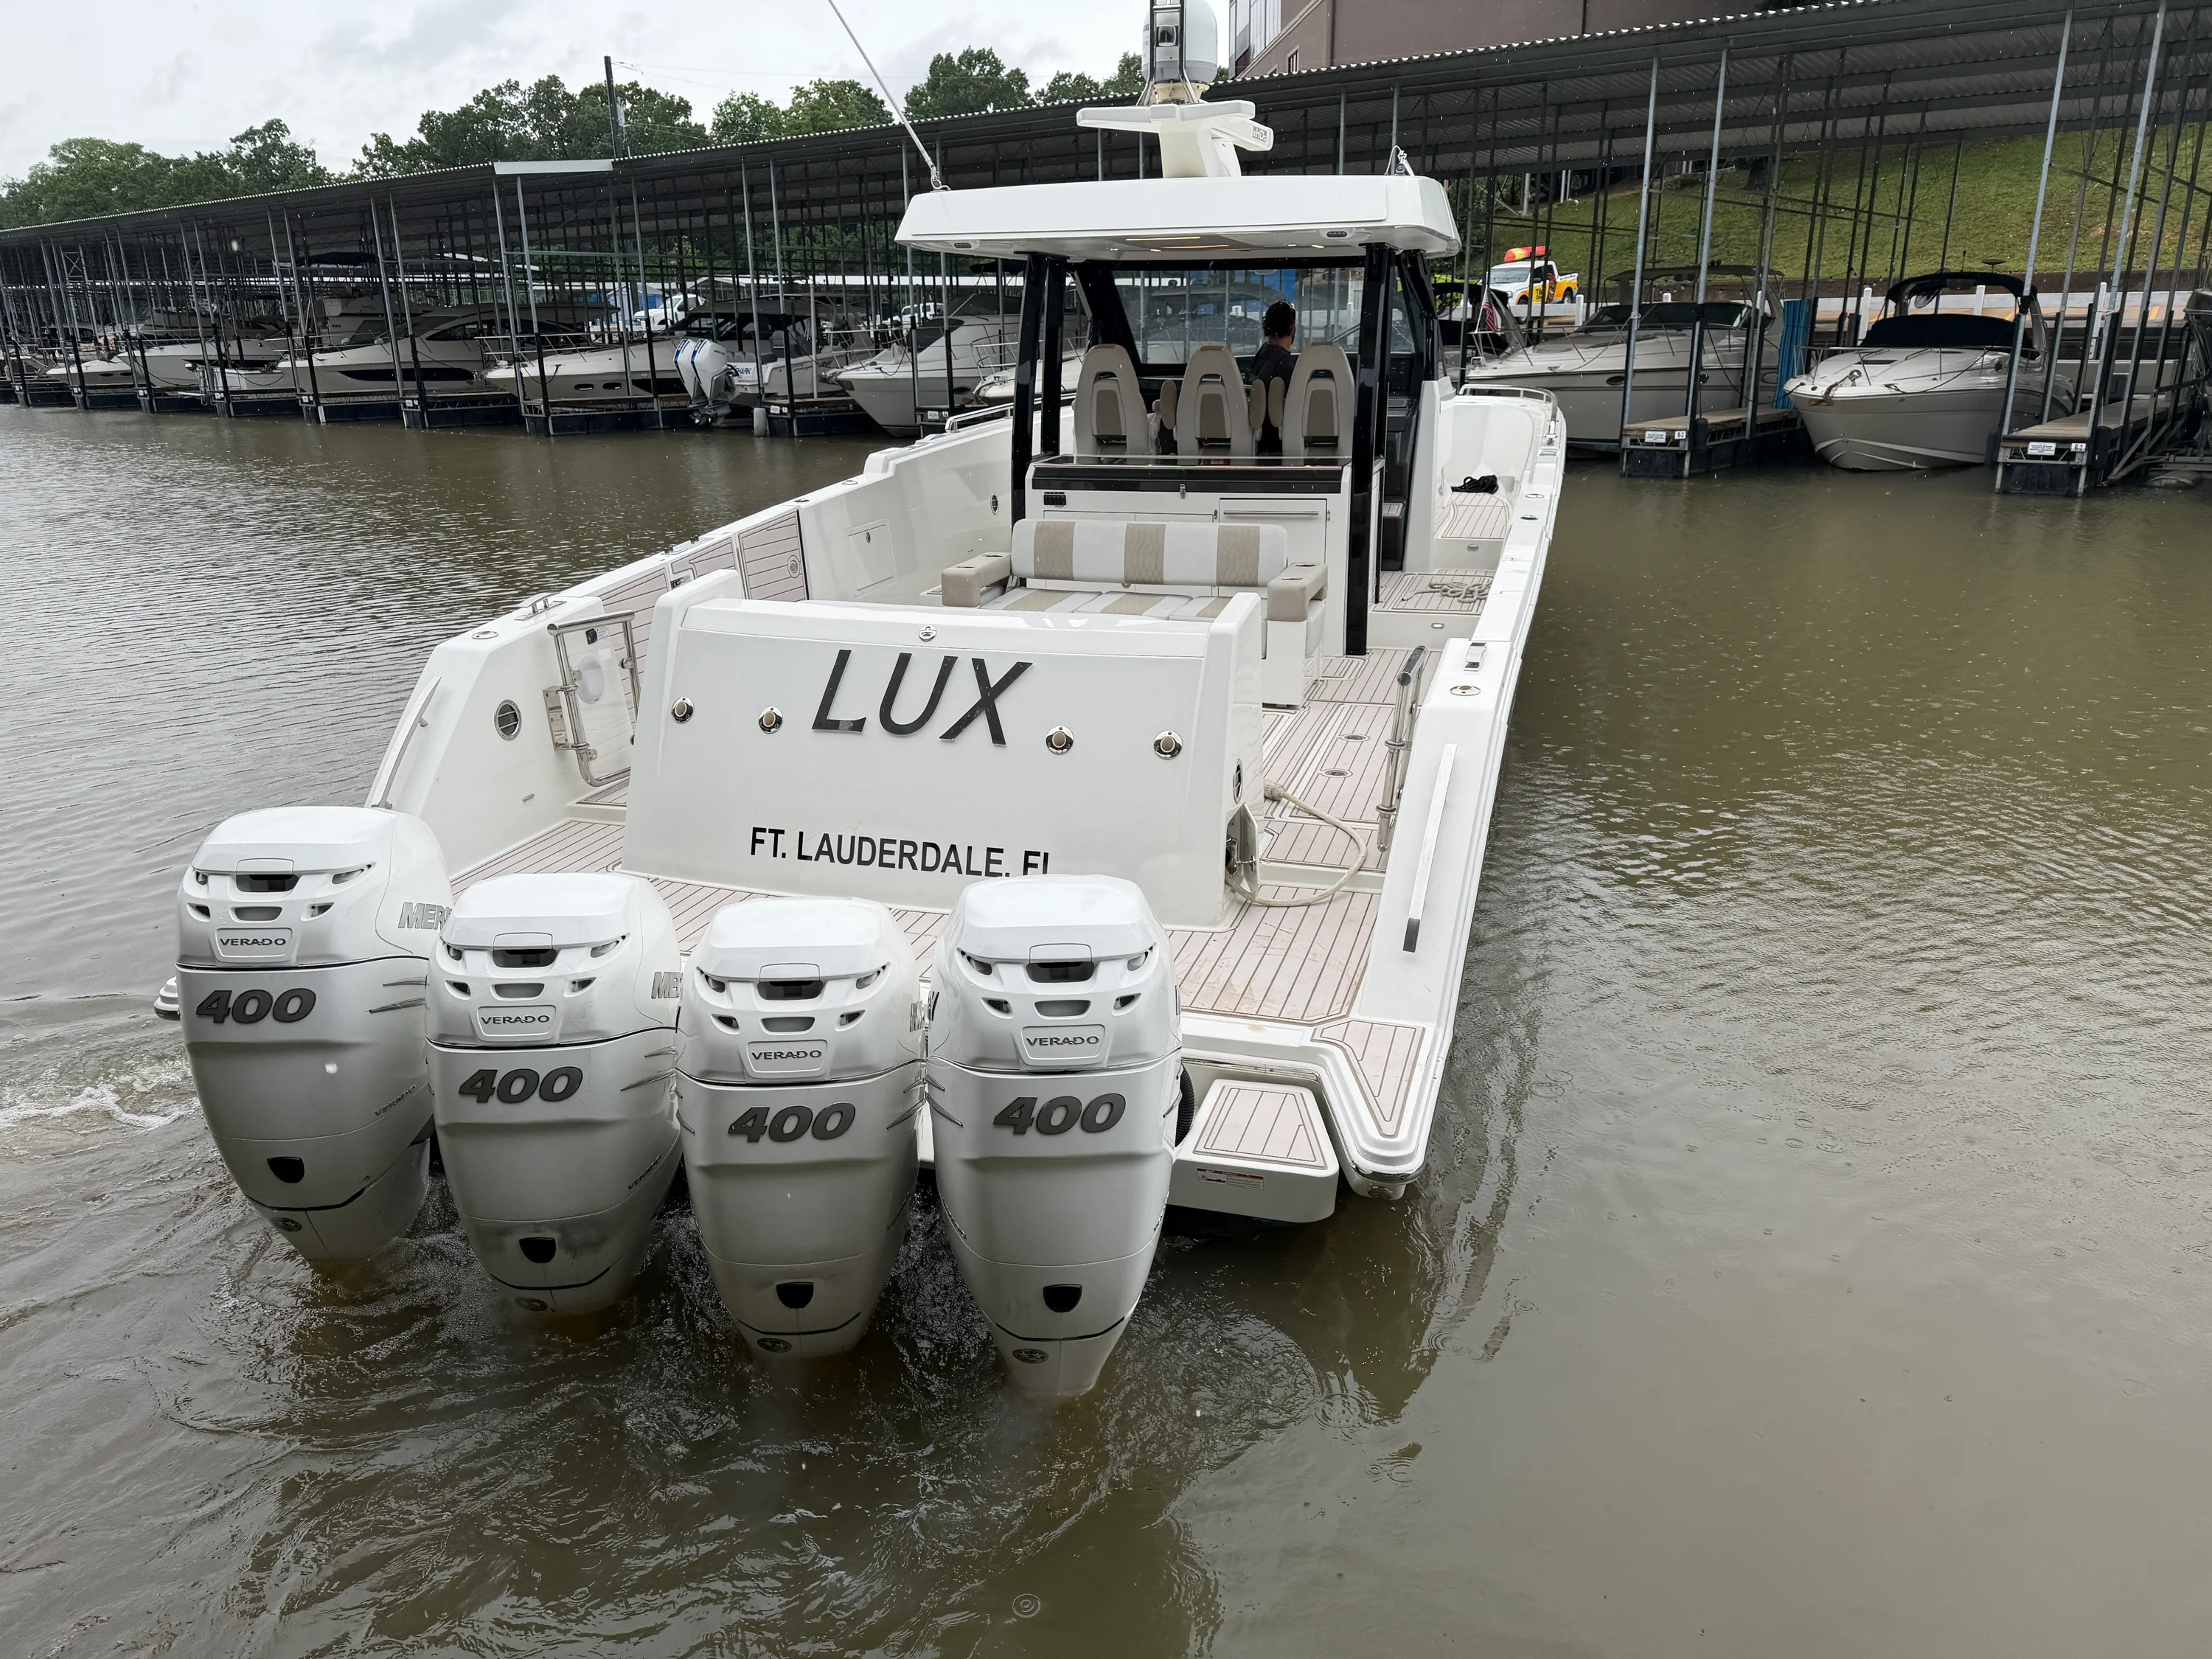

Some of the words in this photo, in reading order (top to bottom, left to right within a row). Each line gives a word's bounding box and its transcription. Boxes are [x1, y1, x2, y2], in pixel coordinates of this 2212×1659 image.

[812, 649, 1033, 746] LUX
[751, 827, 786, 858] FT.
[220, 938, 287, 946] VERADO
[196, 988, 316, 1023] 400
[481, 1015, 550, 1024] VERADO
[751, 1050, 822, 1060] VERADO
[1026, 1036, 1099, 1046] VERADO
[459, 1066, 583, 1103] 400
[728, 1102, 855, 1143] 400
[993, 1093, 1126, 1135] 400
